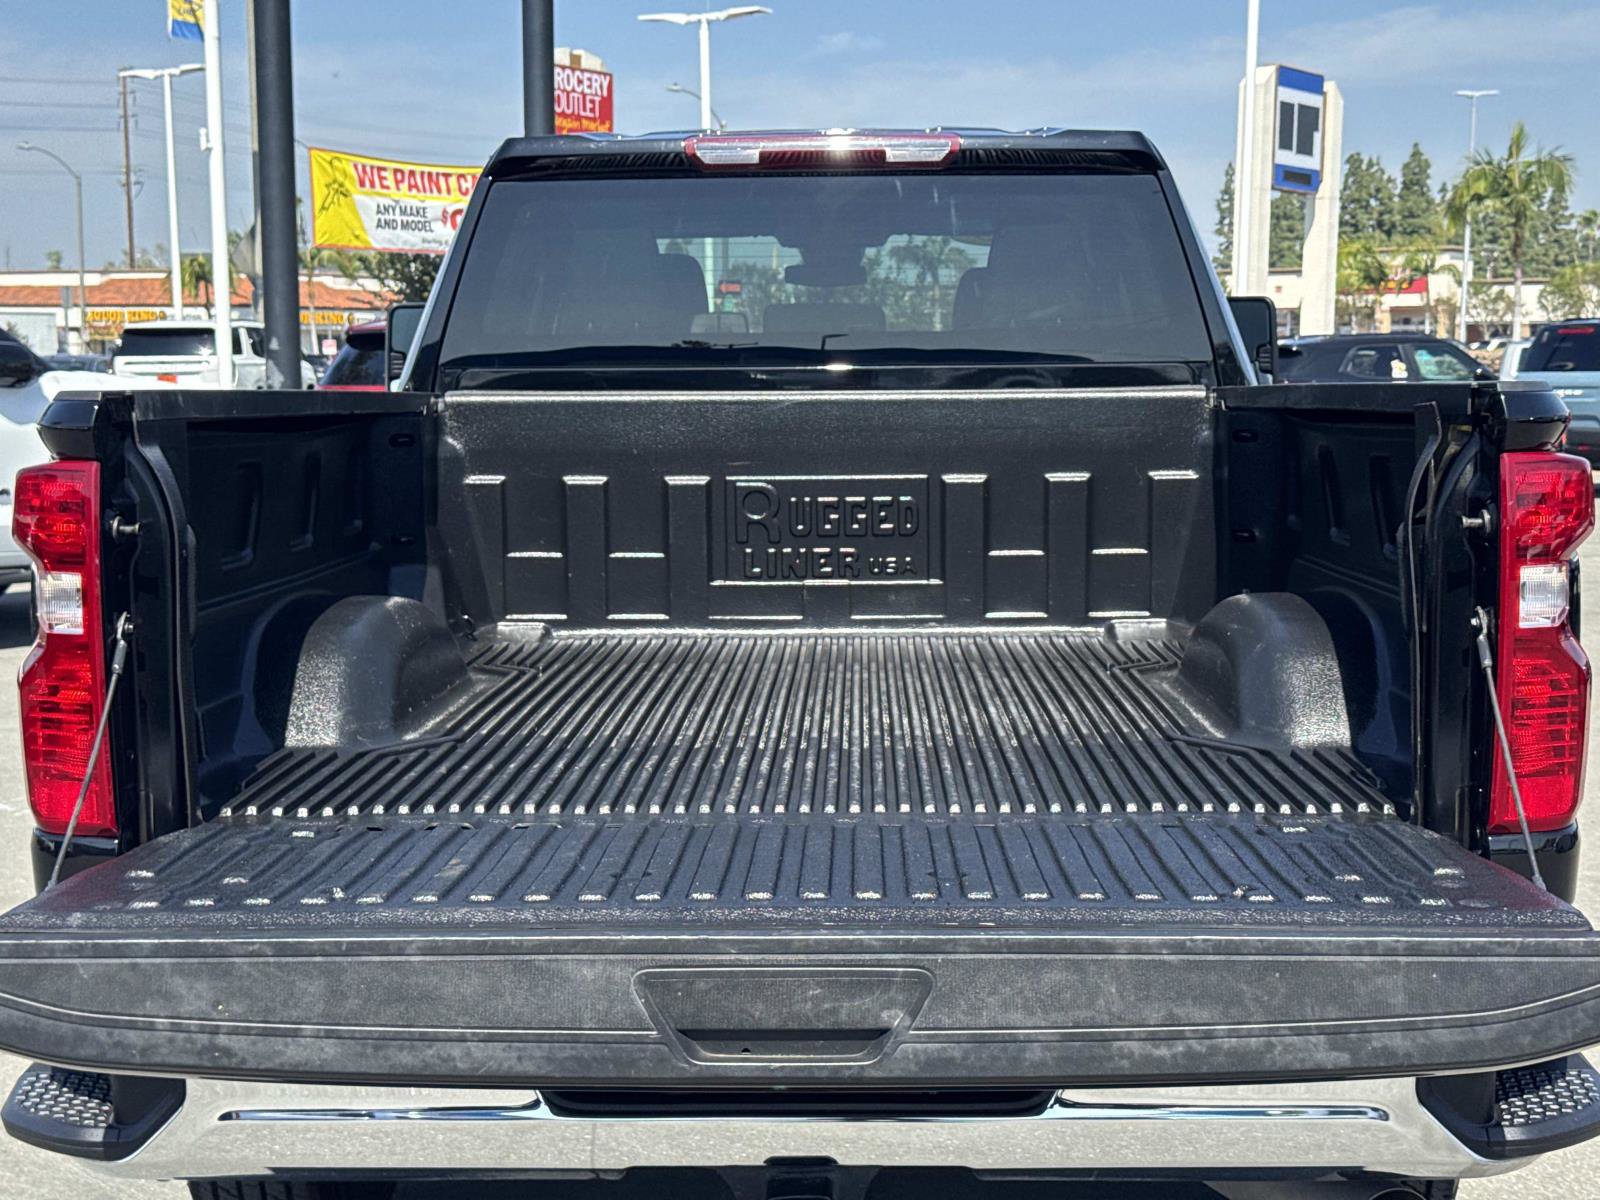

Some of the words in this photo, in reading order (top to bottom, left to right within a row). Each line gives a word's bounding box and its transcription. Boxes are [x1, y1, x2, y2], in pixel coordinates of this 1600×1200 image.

[554, 90, 602, 119] OUTLET
[353, 163, 391, 190] WE
[393, 168, 454, 195] PAINT
[376, 203, 399, 216] ANY
[400, 206, 428, 219] MAKE
[376, 218, 398, 229] AND
[400, 221, 434, 233] MODEL
[735, 482, 919, 544] RUGGED
[744, 548, 860, 579] LINER
[869, 556, 917, 575] USA
